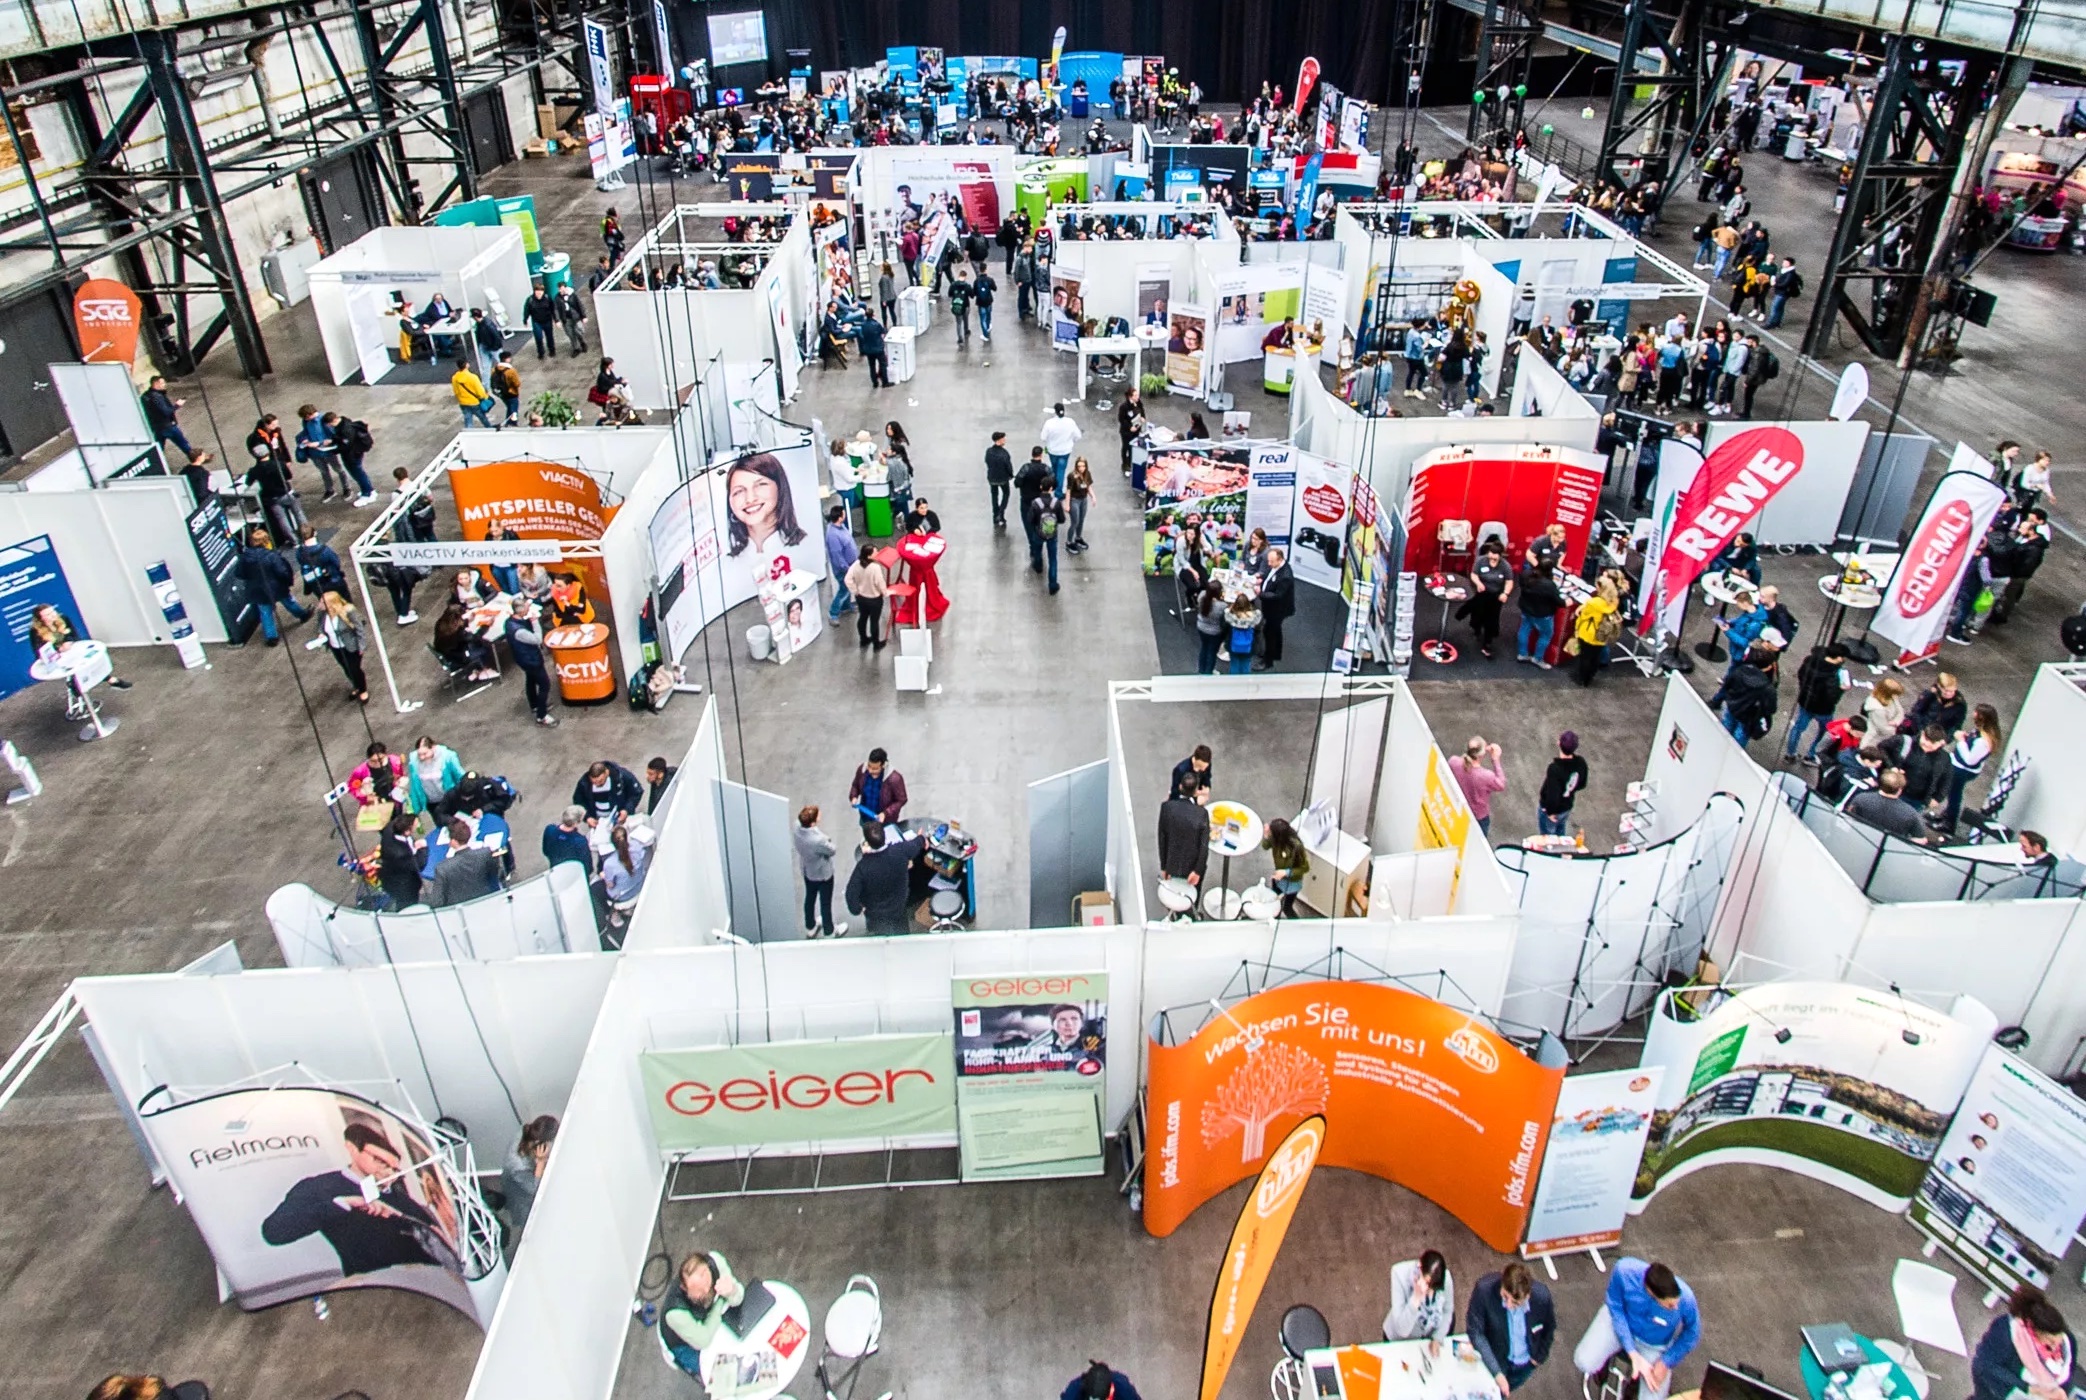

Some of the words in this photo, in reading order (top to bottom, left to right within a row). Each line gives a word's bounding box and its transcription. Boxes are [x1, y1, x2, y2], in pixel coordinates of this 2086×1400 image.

[589, 28, 599, 55] IHK
[1259, 452, 1289, 464] real
[464, 498, 576, 521] MITSPIELER
[1671, 448, 1796, 562] REWE
[501, 517, 526, 527] OMM
[398, 547, 456, 559] VIACTIV
[461, 547, 555, 559] Krankenkasse
[1205, 1014, 1297, 1065] Wachsen
[1304, 1002, 1349, 1027] Sie
[1321, 1022, 1359, 1040] mit
[1368, 1028, 1426, 1058] uns!
[189, 1135, 320, 1168] fielmann
[1160, 1100, 1181, 1188] jobs.ifm.com
[1502, 1120, 1540, 1207] jobs.ifm.com
